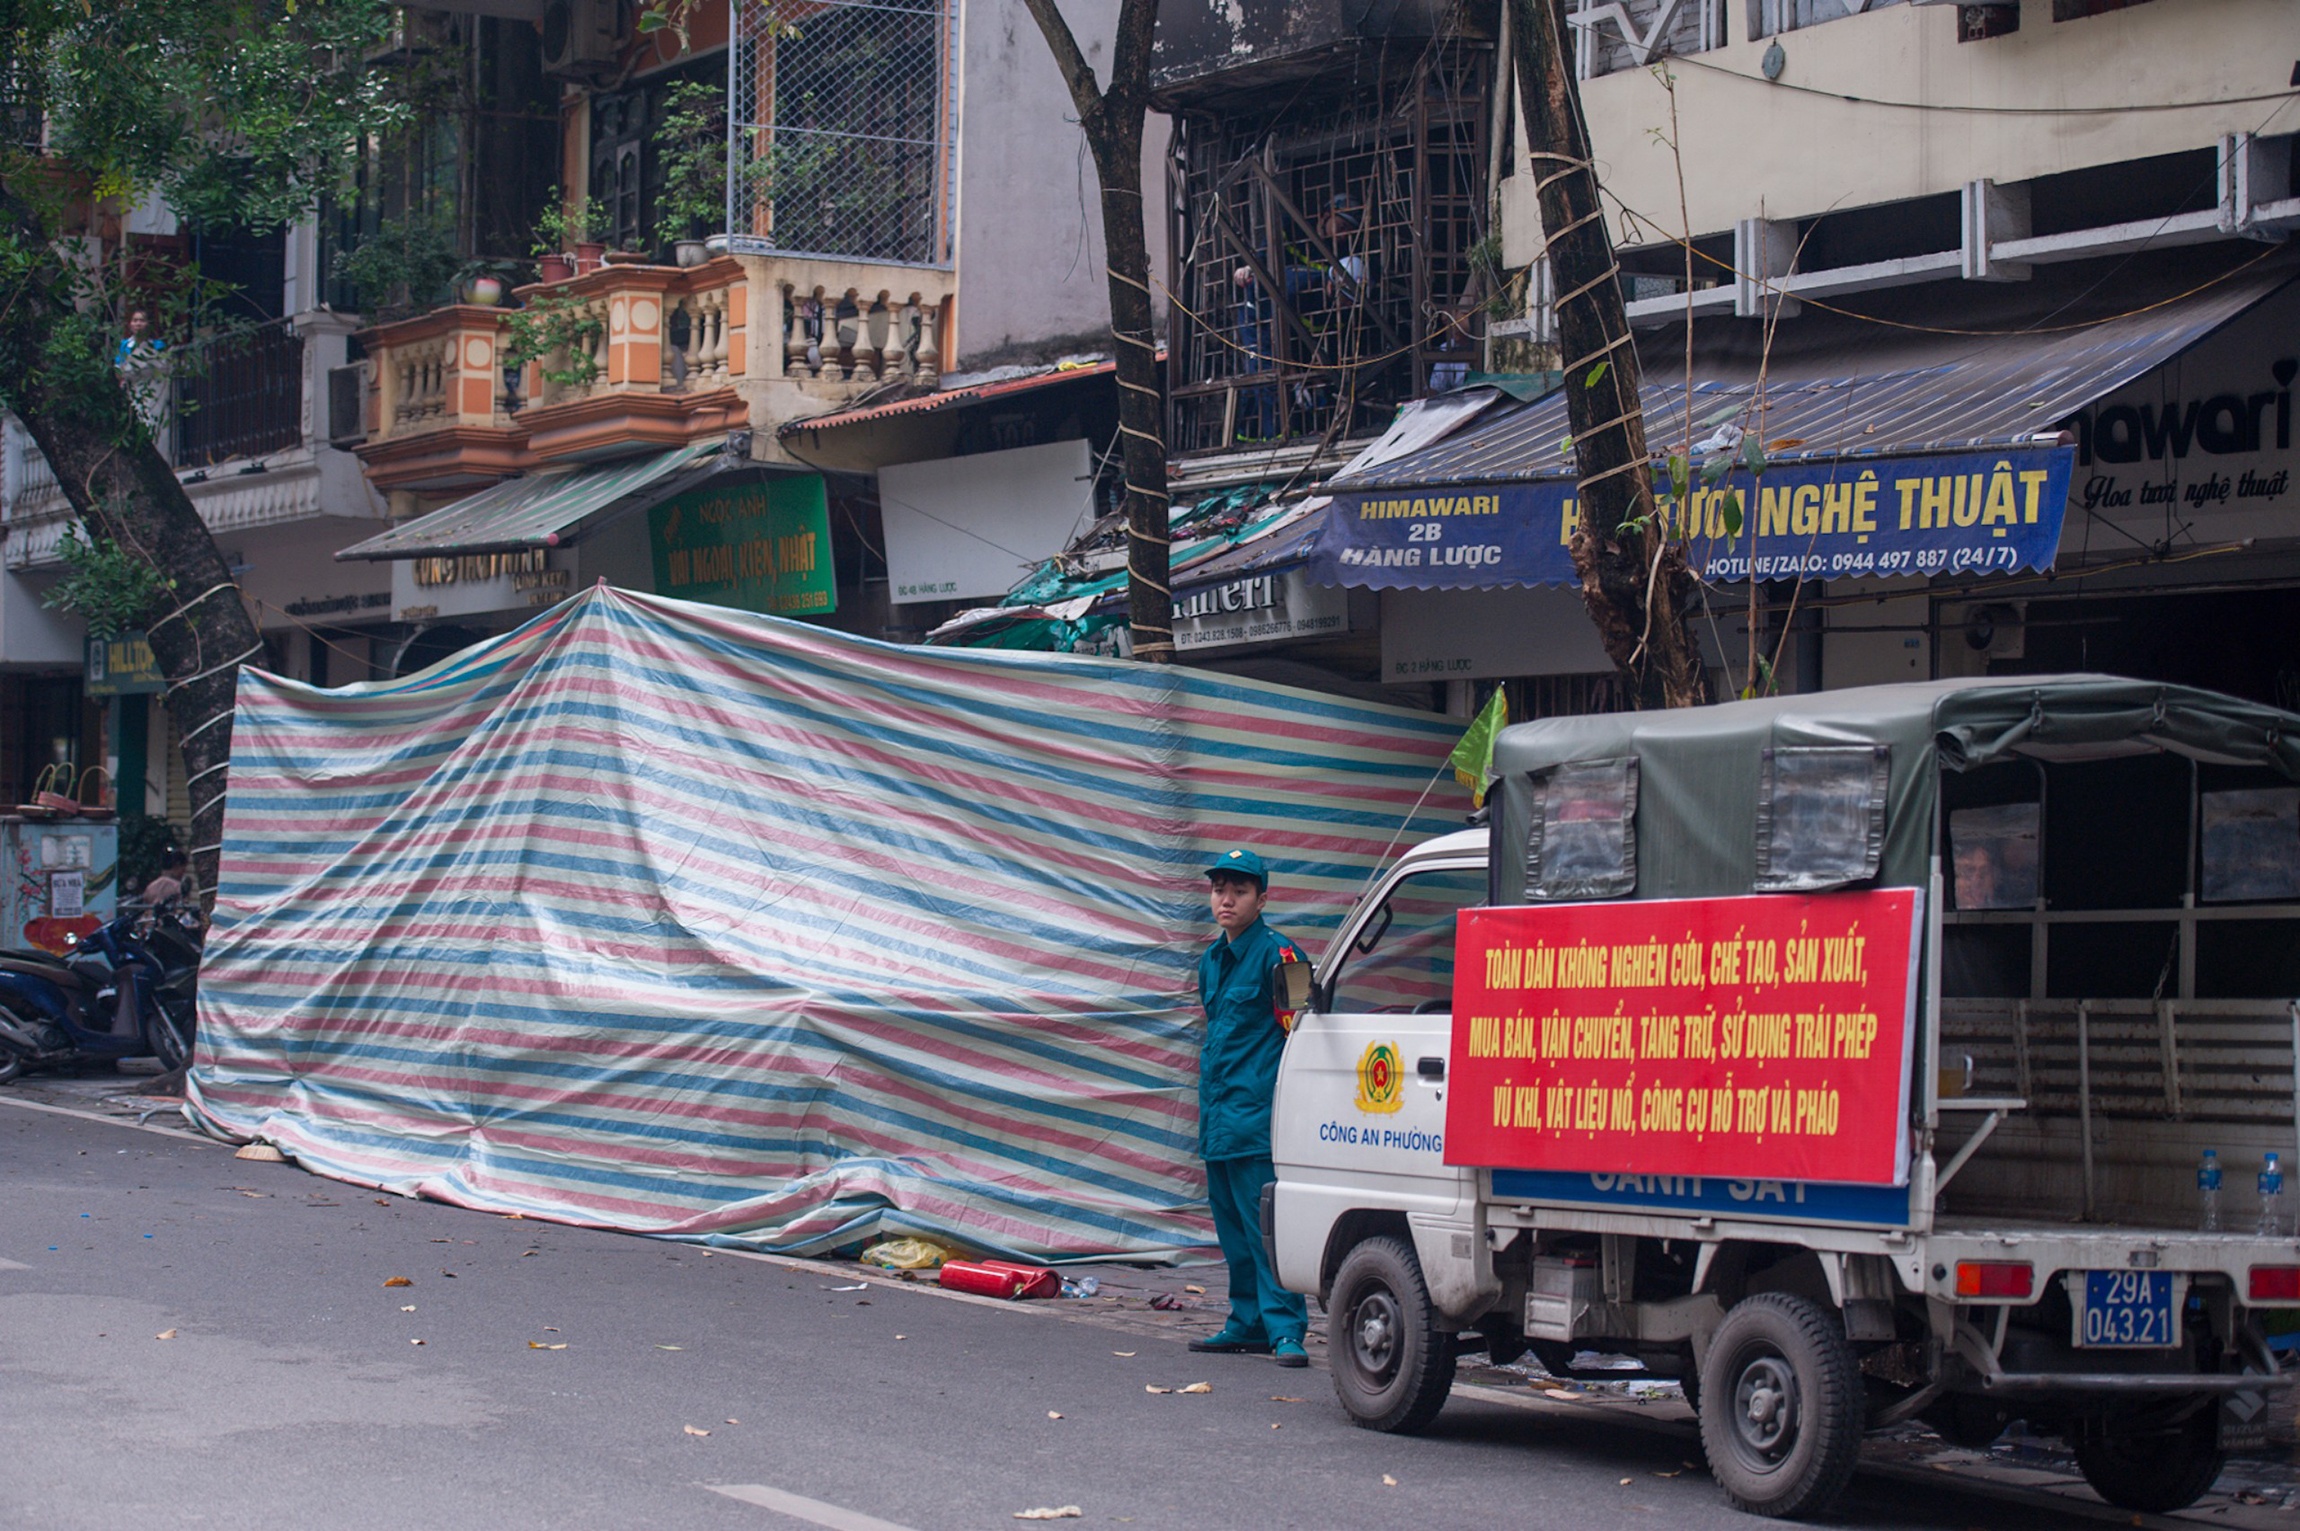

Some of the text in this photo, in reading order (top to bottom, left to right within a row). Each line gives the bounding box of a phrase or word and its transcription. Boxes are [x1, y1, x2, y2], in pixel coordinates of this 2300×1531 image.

[1759, 470, 1879, 543] NGHỆ
[1895, 460, 2048, 538] THUẬT
[2084, 469, 2290, 509] Hoa tươi nghệ thuật
[739, 494, 766, 518] ANH
[1360, 495, 1499, 520] HIMAWARI
[1408, 522, 1442, 542] 2B
[1339, 544, 1502, 569] HÀNG LƯỢC
[1705, 547, 2017, 575] HOTLINE/ZALO: 0944 497 887 (24/7)
[1485, 919, 1867, 994] TOÀN DÂN KHÔNG NGHIÊN CỨU, CHẾ TẠO, SẢN XUẤT,
[1468, 995, 1878, 1068] MUA BÁN, VẬN CHUYỂN, TÀNG TRỮ, SỬ DỤNG TRÁI PHÉP
[1493, 1071, 1839, 1144] VŨ KHÍ, VẬT LIỆU NỔ, CÔNG CỤ HỖ TRỢ VÀ PHÁO
[1320, 1120, 1442, 1152] CÔNG AN PHƯỜNG
[2106, 1271, 2152, 1304] 29A
[2087, 1307, 2168, 1342] 043.21
